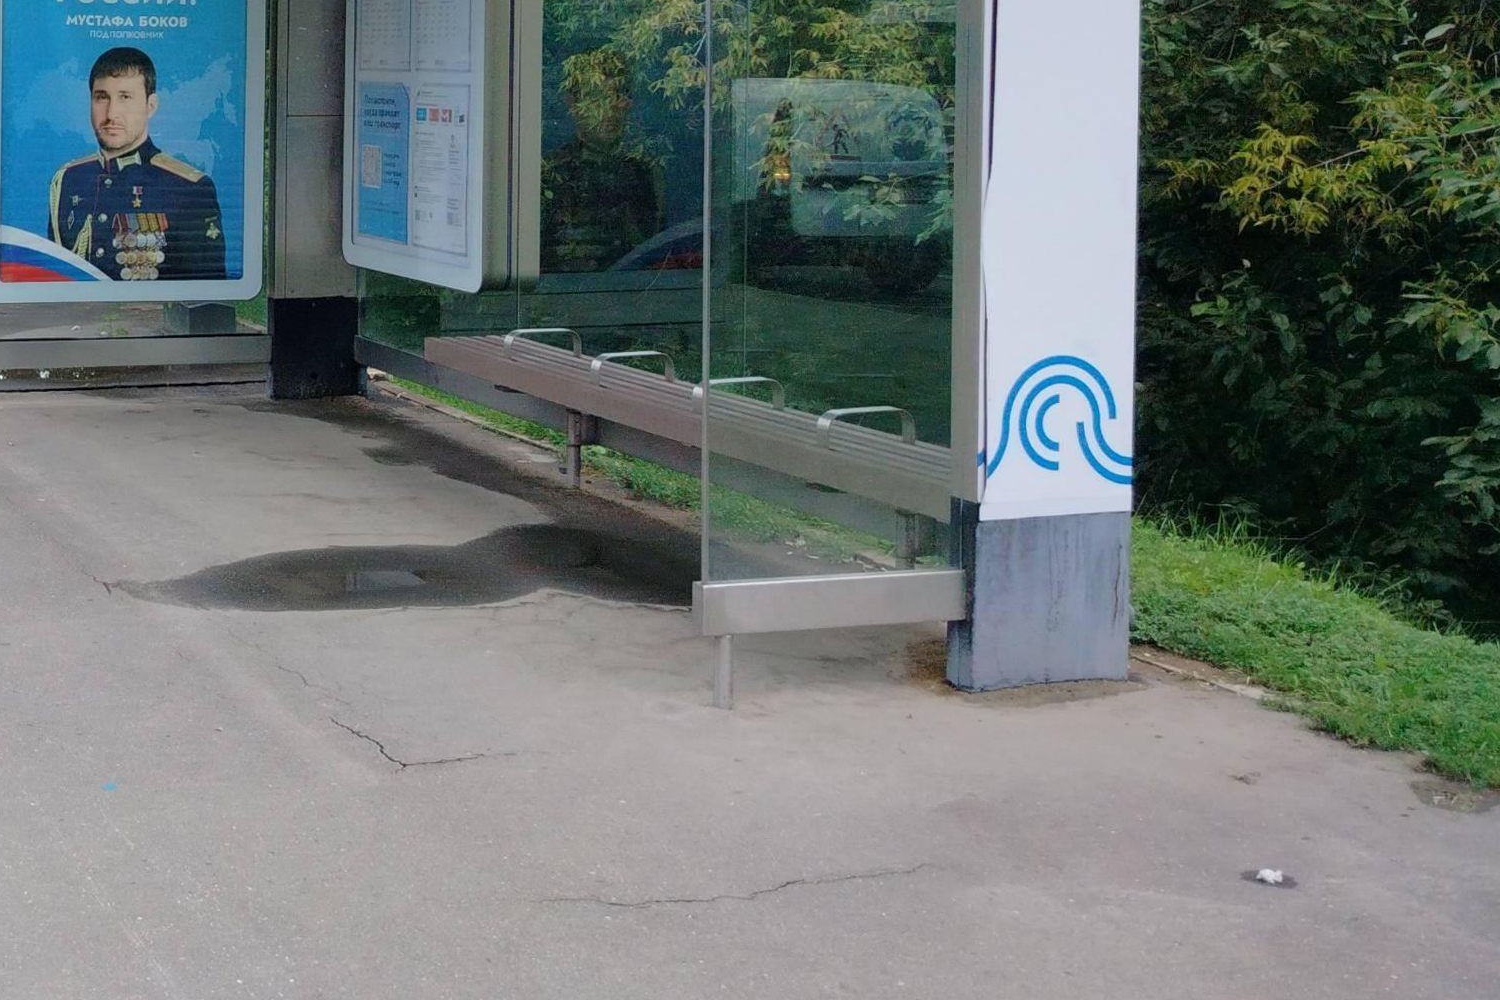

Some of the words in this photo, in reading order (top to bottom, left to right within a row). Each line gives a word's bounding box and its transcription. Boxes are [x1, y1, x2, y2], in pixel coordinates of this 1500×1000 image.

[66, 14, 134, 27] МУСТАФА
[139, 16, 188, 28] БОКОВ
[89, 29, 165, 40] ПОДПОЛКОВНИК
